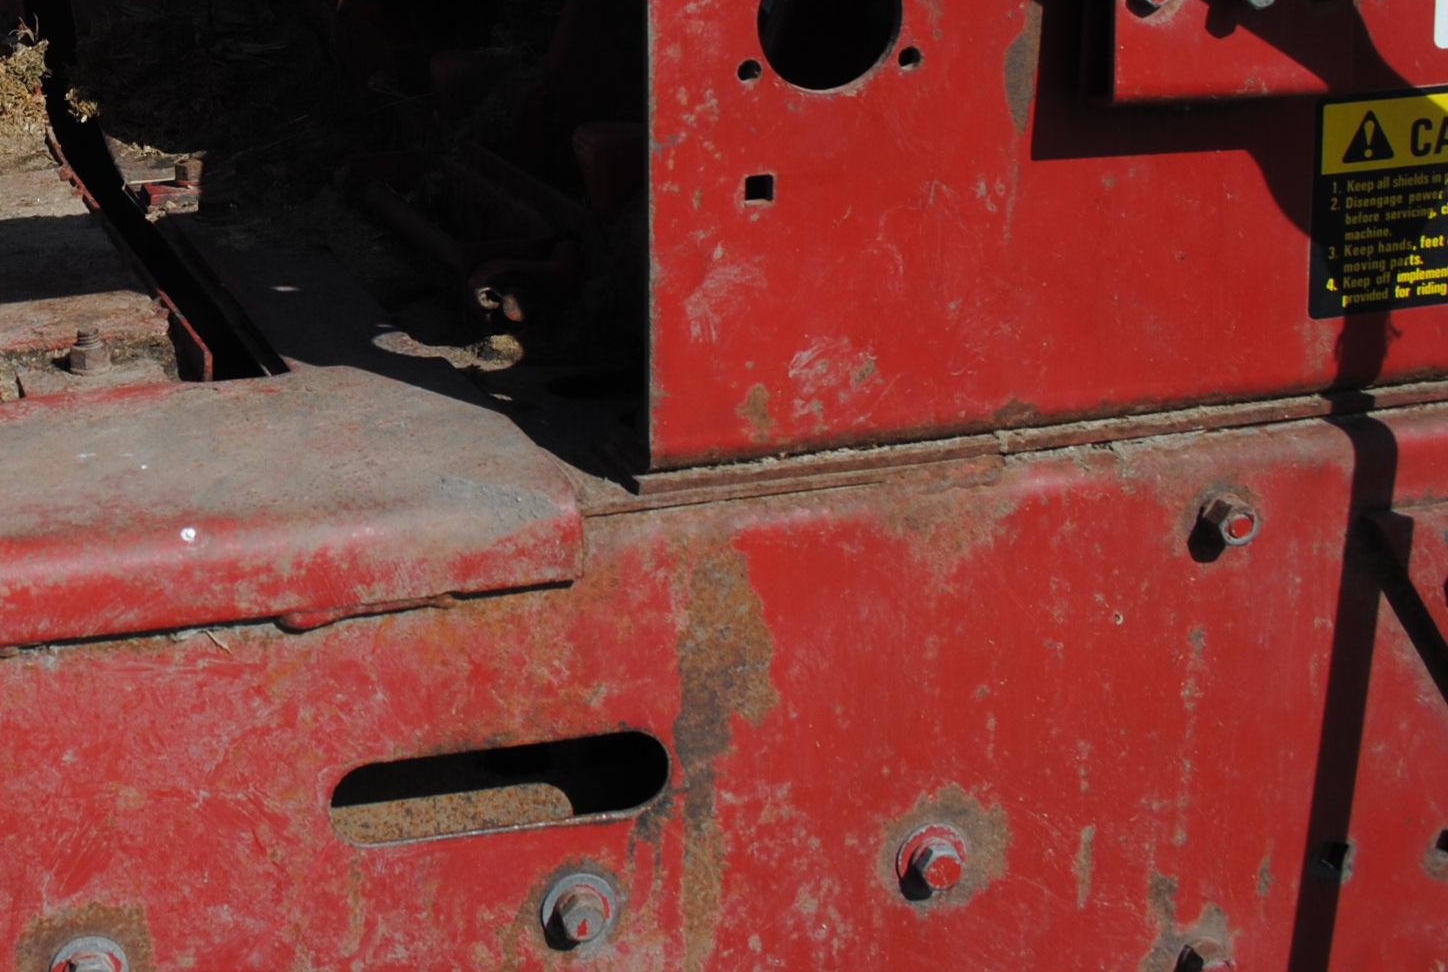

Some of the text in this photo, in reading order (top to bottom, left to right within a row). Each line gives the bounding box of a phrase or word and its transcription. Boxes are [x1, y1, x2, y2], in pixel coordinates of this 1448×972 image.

[1347, 180, 1373, 193] Keep
[1377, 176, 1390, 188] all
[1393, 173, 1429, 187] shields
[1346, 194, 1402, 208] Disengage
[1345, 213, 1379, 225] before
[1344, 245, 1373, 257] Keep
[1420, 235, 1444, 248] feet
[1344, 255, 1424, 272] moving parts.
[1343, 276, 1370, 289] Keep
[1376, 271, 1390, 284] off
[1342, 282, 1447, 307] provided for riding
